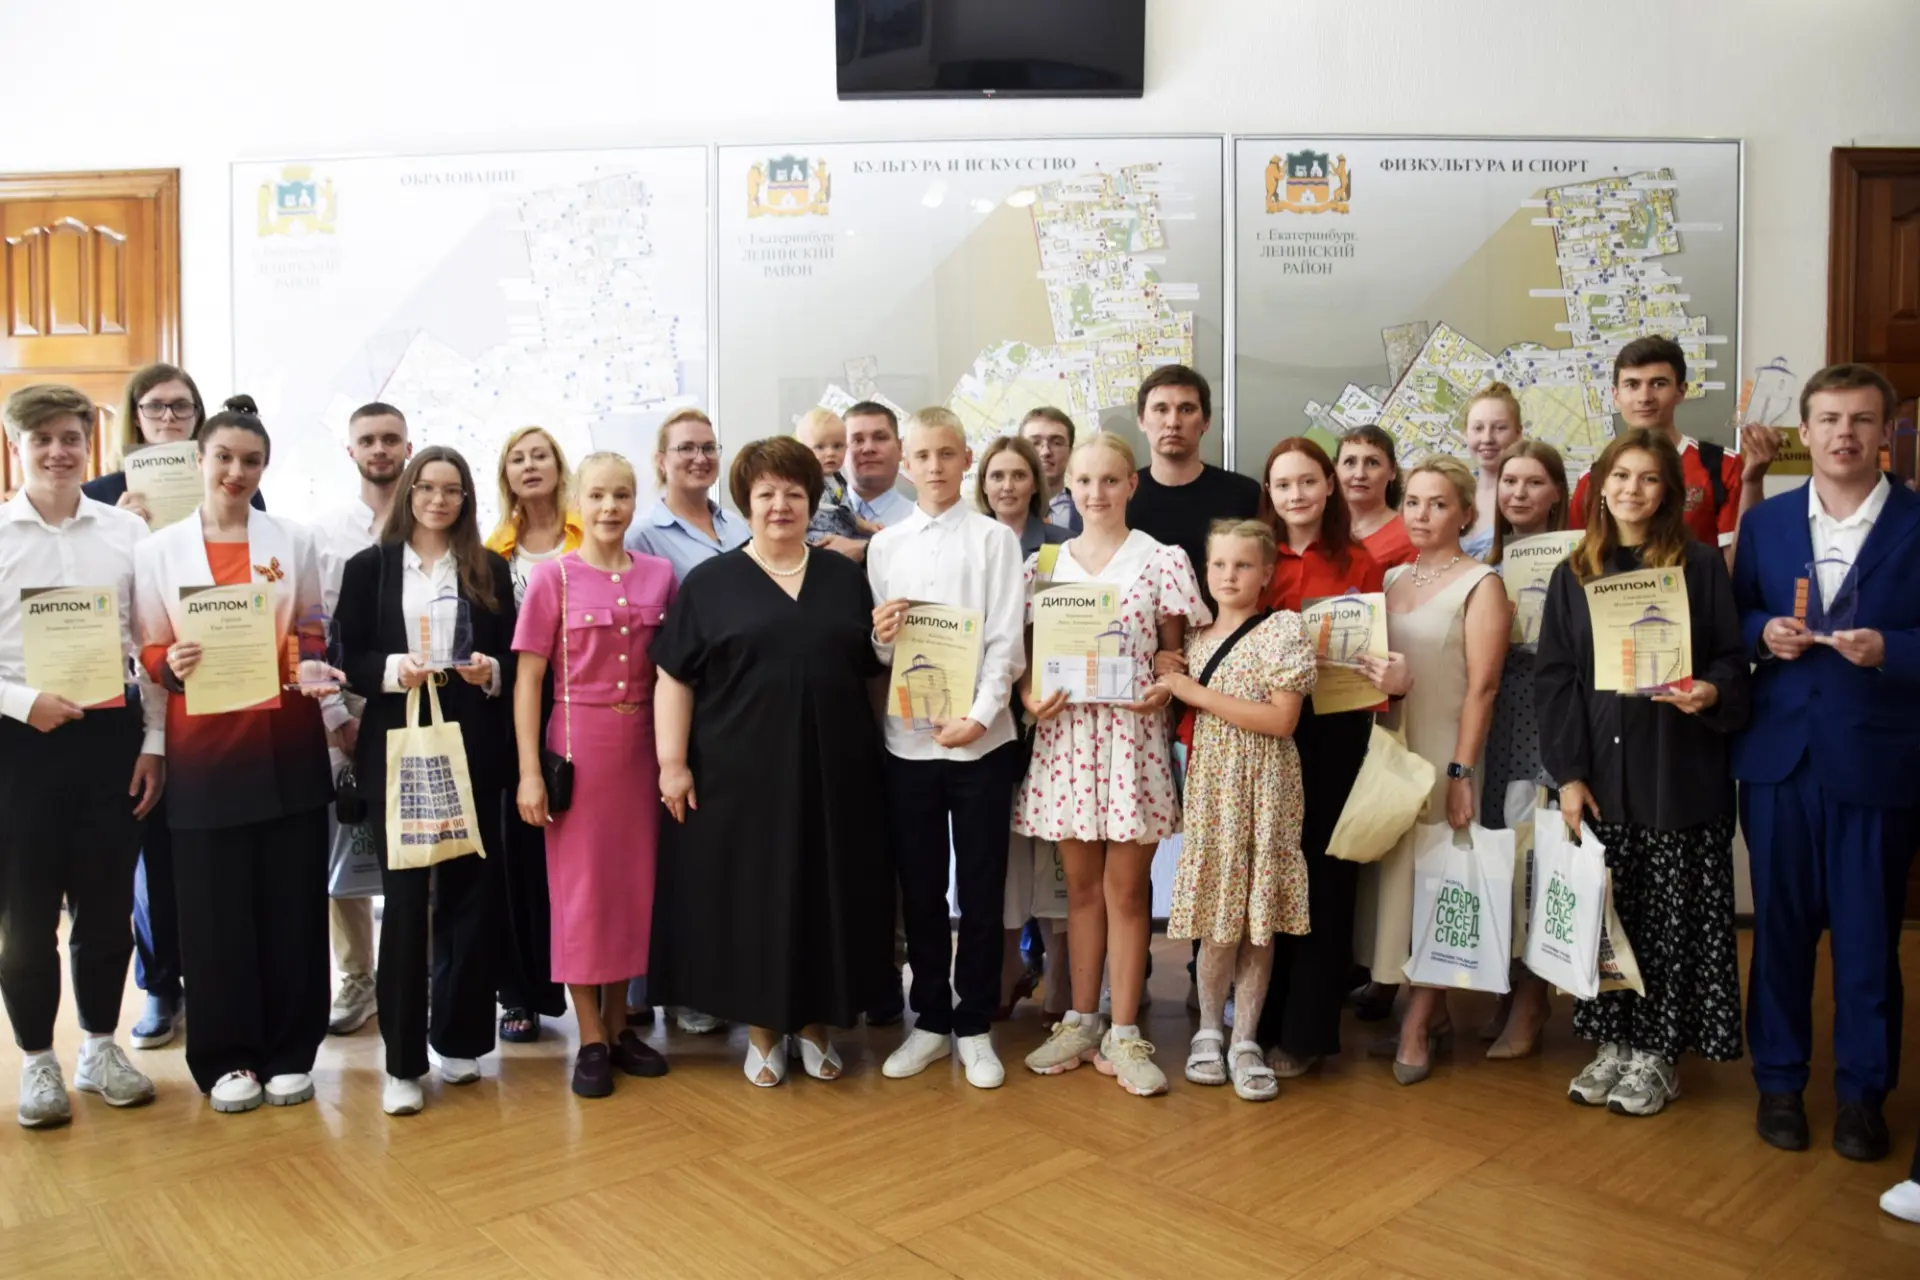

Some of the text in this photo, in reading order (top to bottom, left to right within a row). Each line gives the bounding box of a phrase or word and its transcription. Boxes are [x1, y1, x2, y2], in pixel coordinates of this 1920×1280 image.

[853, 156, 1076, 174] КУЛЬТУРА И ИСКУССТВО
[1379, 157, 1589, 174] ФИЗКУЛЬТУРА И СПОРТ
[741, 245, 836, 262] ЛЕНИНСКИЙ
[1259, 242, 1355, 258] ЛЕНИНСКИЙ
[764, 261, 813, 279] РАЙОН
[1282, 258, 1333, 275] РАЙОН
[131, 455, 186, 470] ДИПЛОМ
[1510, 546, 1563, 559] ДИПЛОМ
[1593, 580, 1657, 595] ДИПЛОМ
[29, 601, 91, 616] ДИПЛОМ
[187, 600, 249, 615] ДИПЛОМ
[1041, 596, 1096, 608] ДИПЛОМ
[904, 614, 959, 632] ДИПЛОМ
